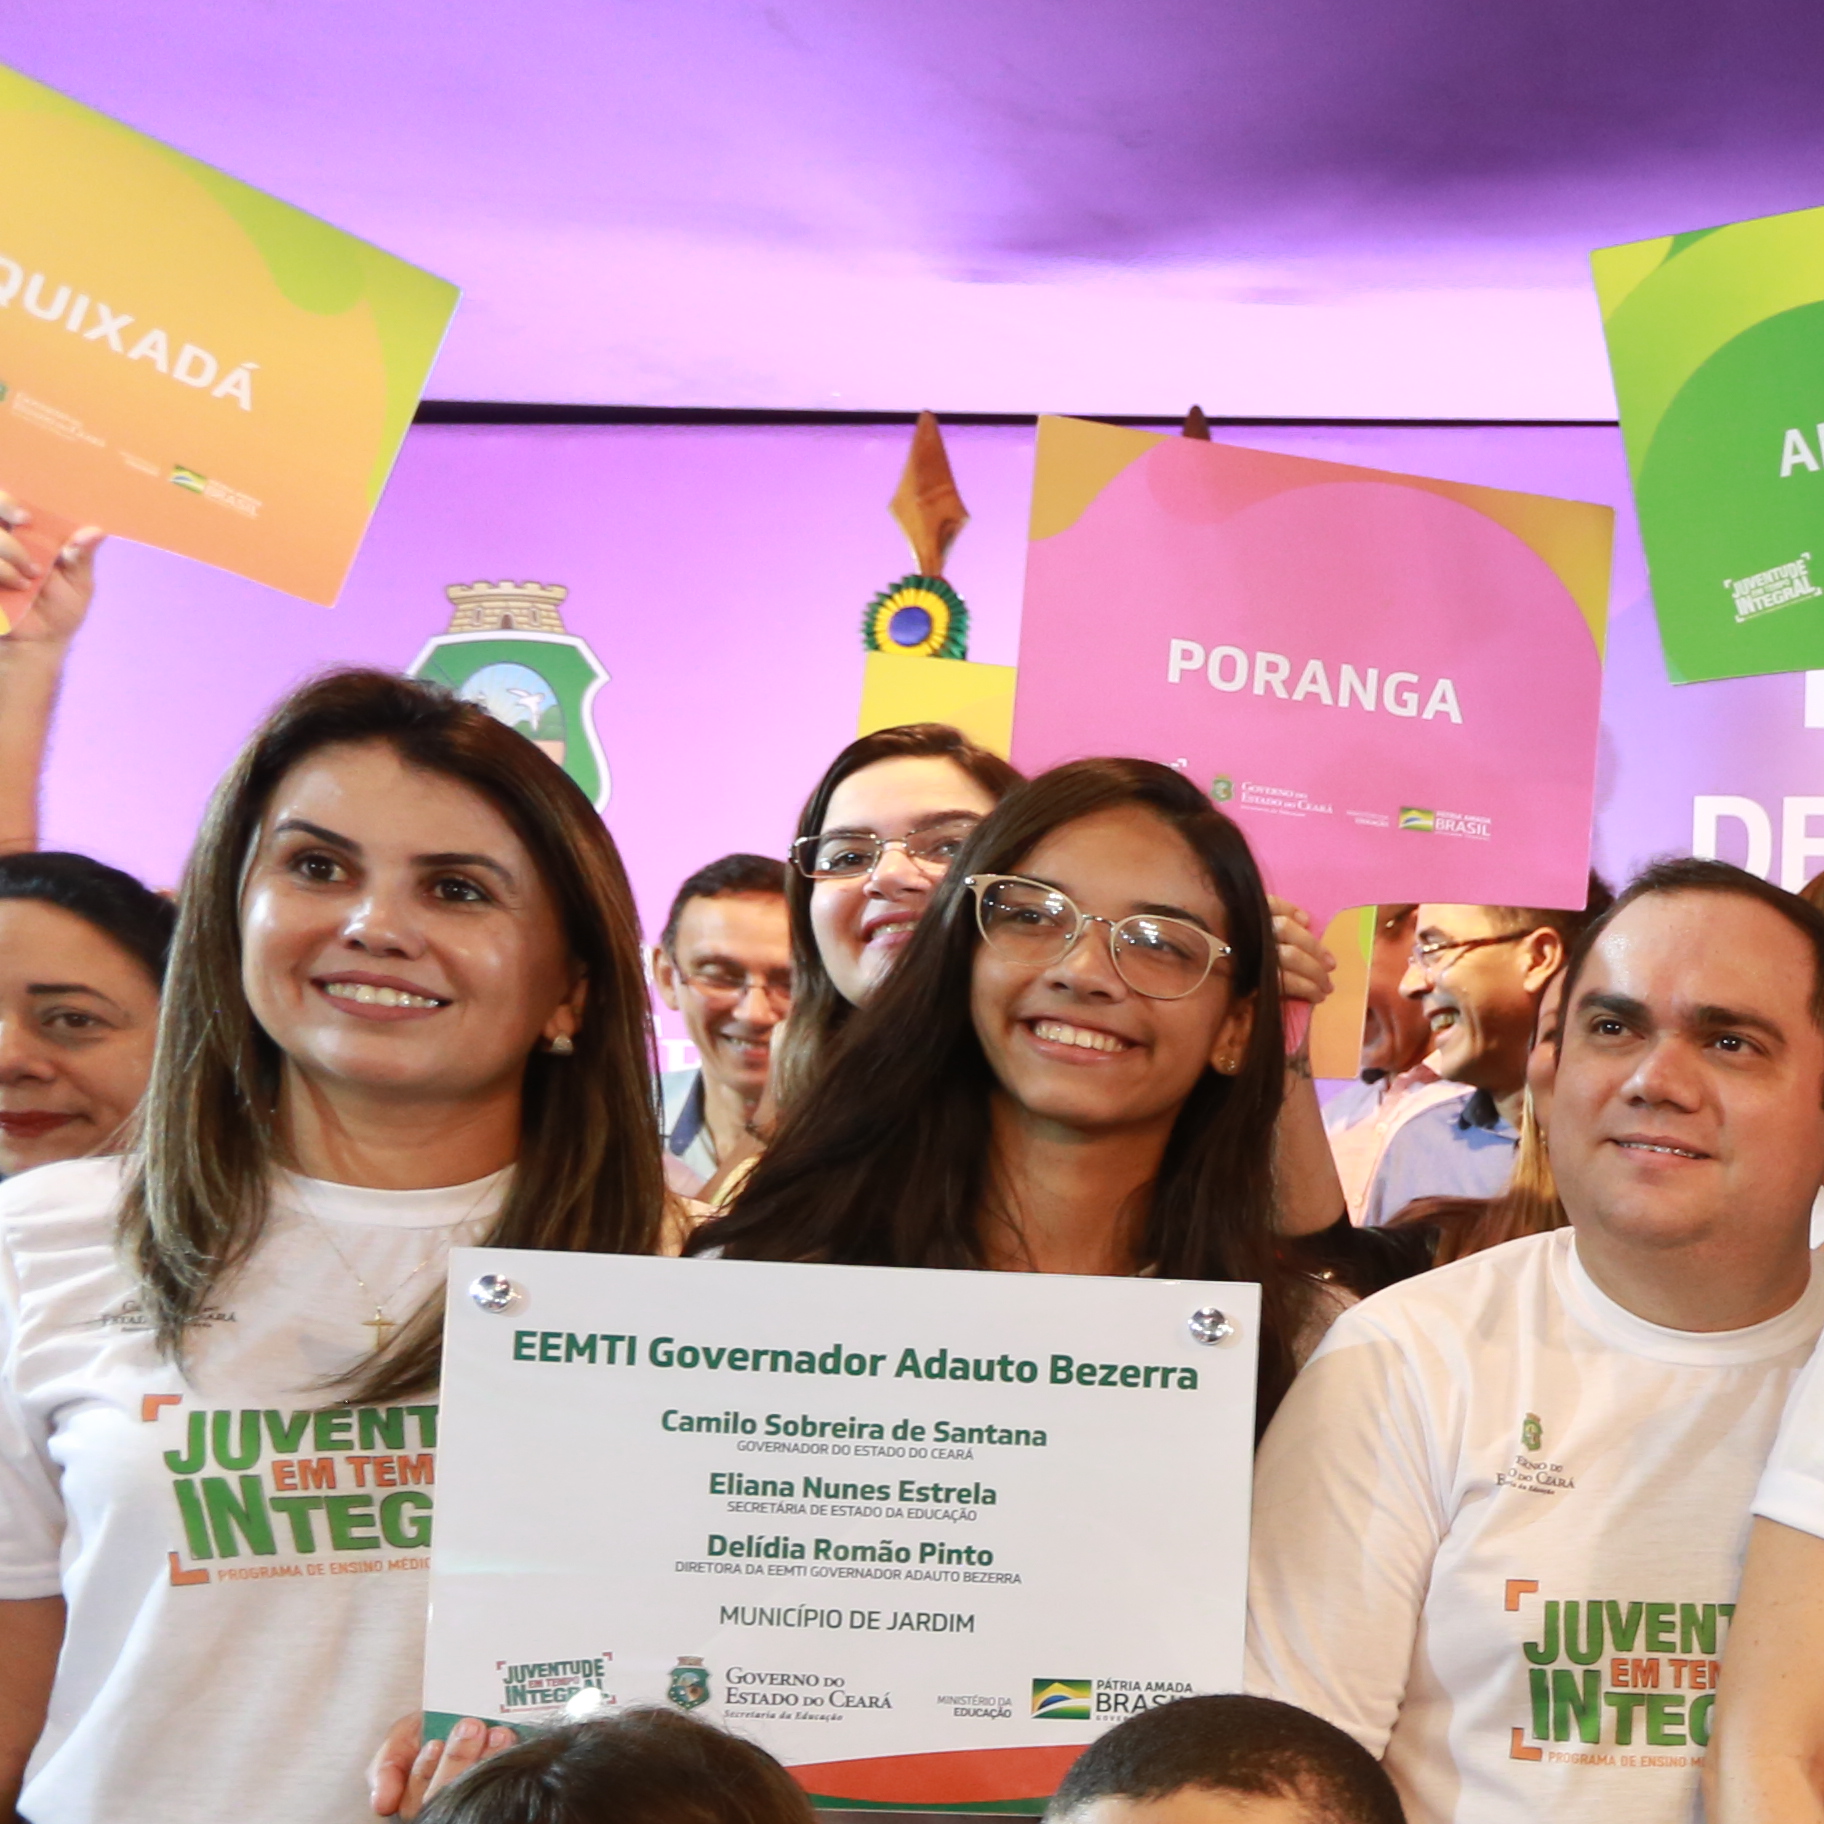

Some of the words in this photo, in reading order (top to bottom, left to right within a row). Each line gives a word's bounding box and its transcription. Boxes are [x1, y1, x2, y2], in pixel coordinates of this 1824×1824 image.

[1166, 636, 1464, 726] PORANGA
[513, 1330, 637, 1366] EEMTI
[649, 1337, 887, 1376] Governador
[894, 1348, 1038, 1383] Adauto
[1050, 1354, 1198, 1390] Bezerra
[164, 1405, 439, 1474] JUVENT
[272, 1459, 336, 1491] EM
[173, 1475, 433, 1560] INTEG
[708, 1534, 805, 1559] Delídia
[814, 1538, 911, 1563] Romão
[919, 1542, 993, 1566] Pinto
[720, 1604, 842, 1629] MUNICÍPIO
[849, 1610, 881, 1630] DE
[886, 1612, 974, 1633] JARDIM
